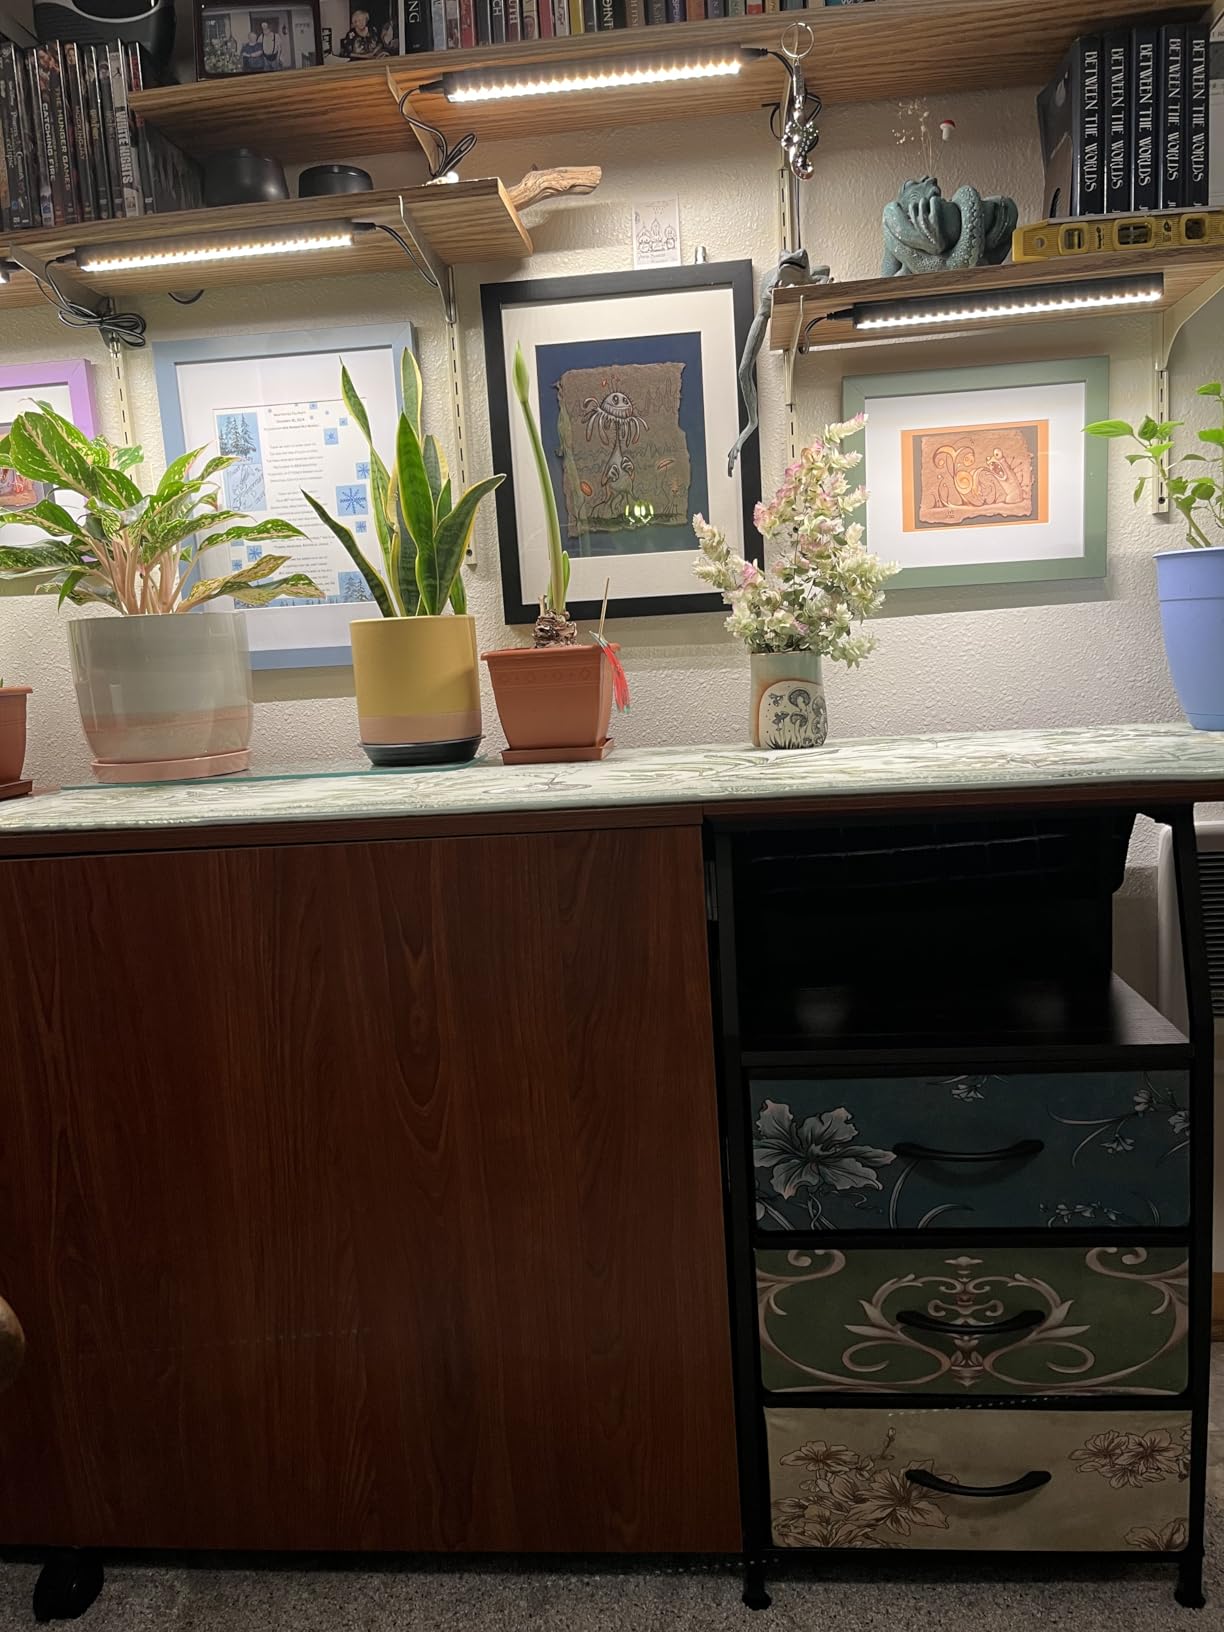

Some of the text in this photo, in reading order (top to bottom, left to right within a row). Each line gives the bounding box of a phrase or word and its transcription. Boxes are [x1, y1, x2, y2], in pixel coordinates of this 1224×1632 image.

[42, 102, 53, 156] CATCHING
[48, 158, 56, 182] FIRE
[57, 109, 68, 153] HUNGER
[75, 105, 85, 160] MOCKINGJAY
[116, 111, 133, 184] WHITE NIGHTS
[1083, 51, 1098, 192] BETWEEN THE WORLDS
[1110, 48, 1125, 189] BETWEEN THE WORLDS
[1138, 43, 1153, 186] BETWEEN THE WORLDS
[1166, 38, 1181, 181] BETWEEN THE WORLDS
[1190, 39, 1206, 182] BETWEEN THE WORLDS
[62, 155, 72, 191] GAMES
